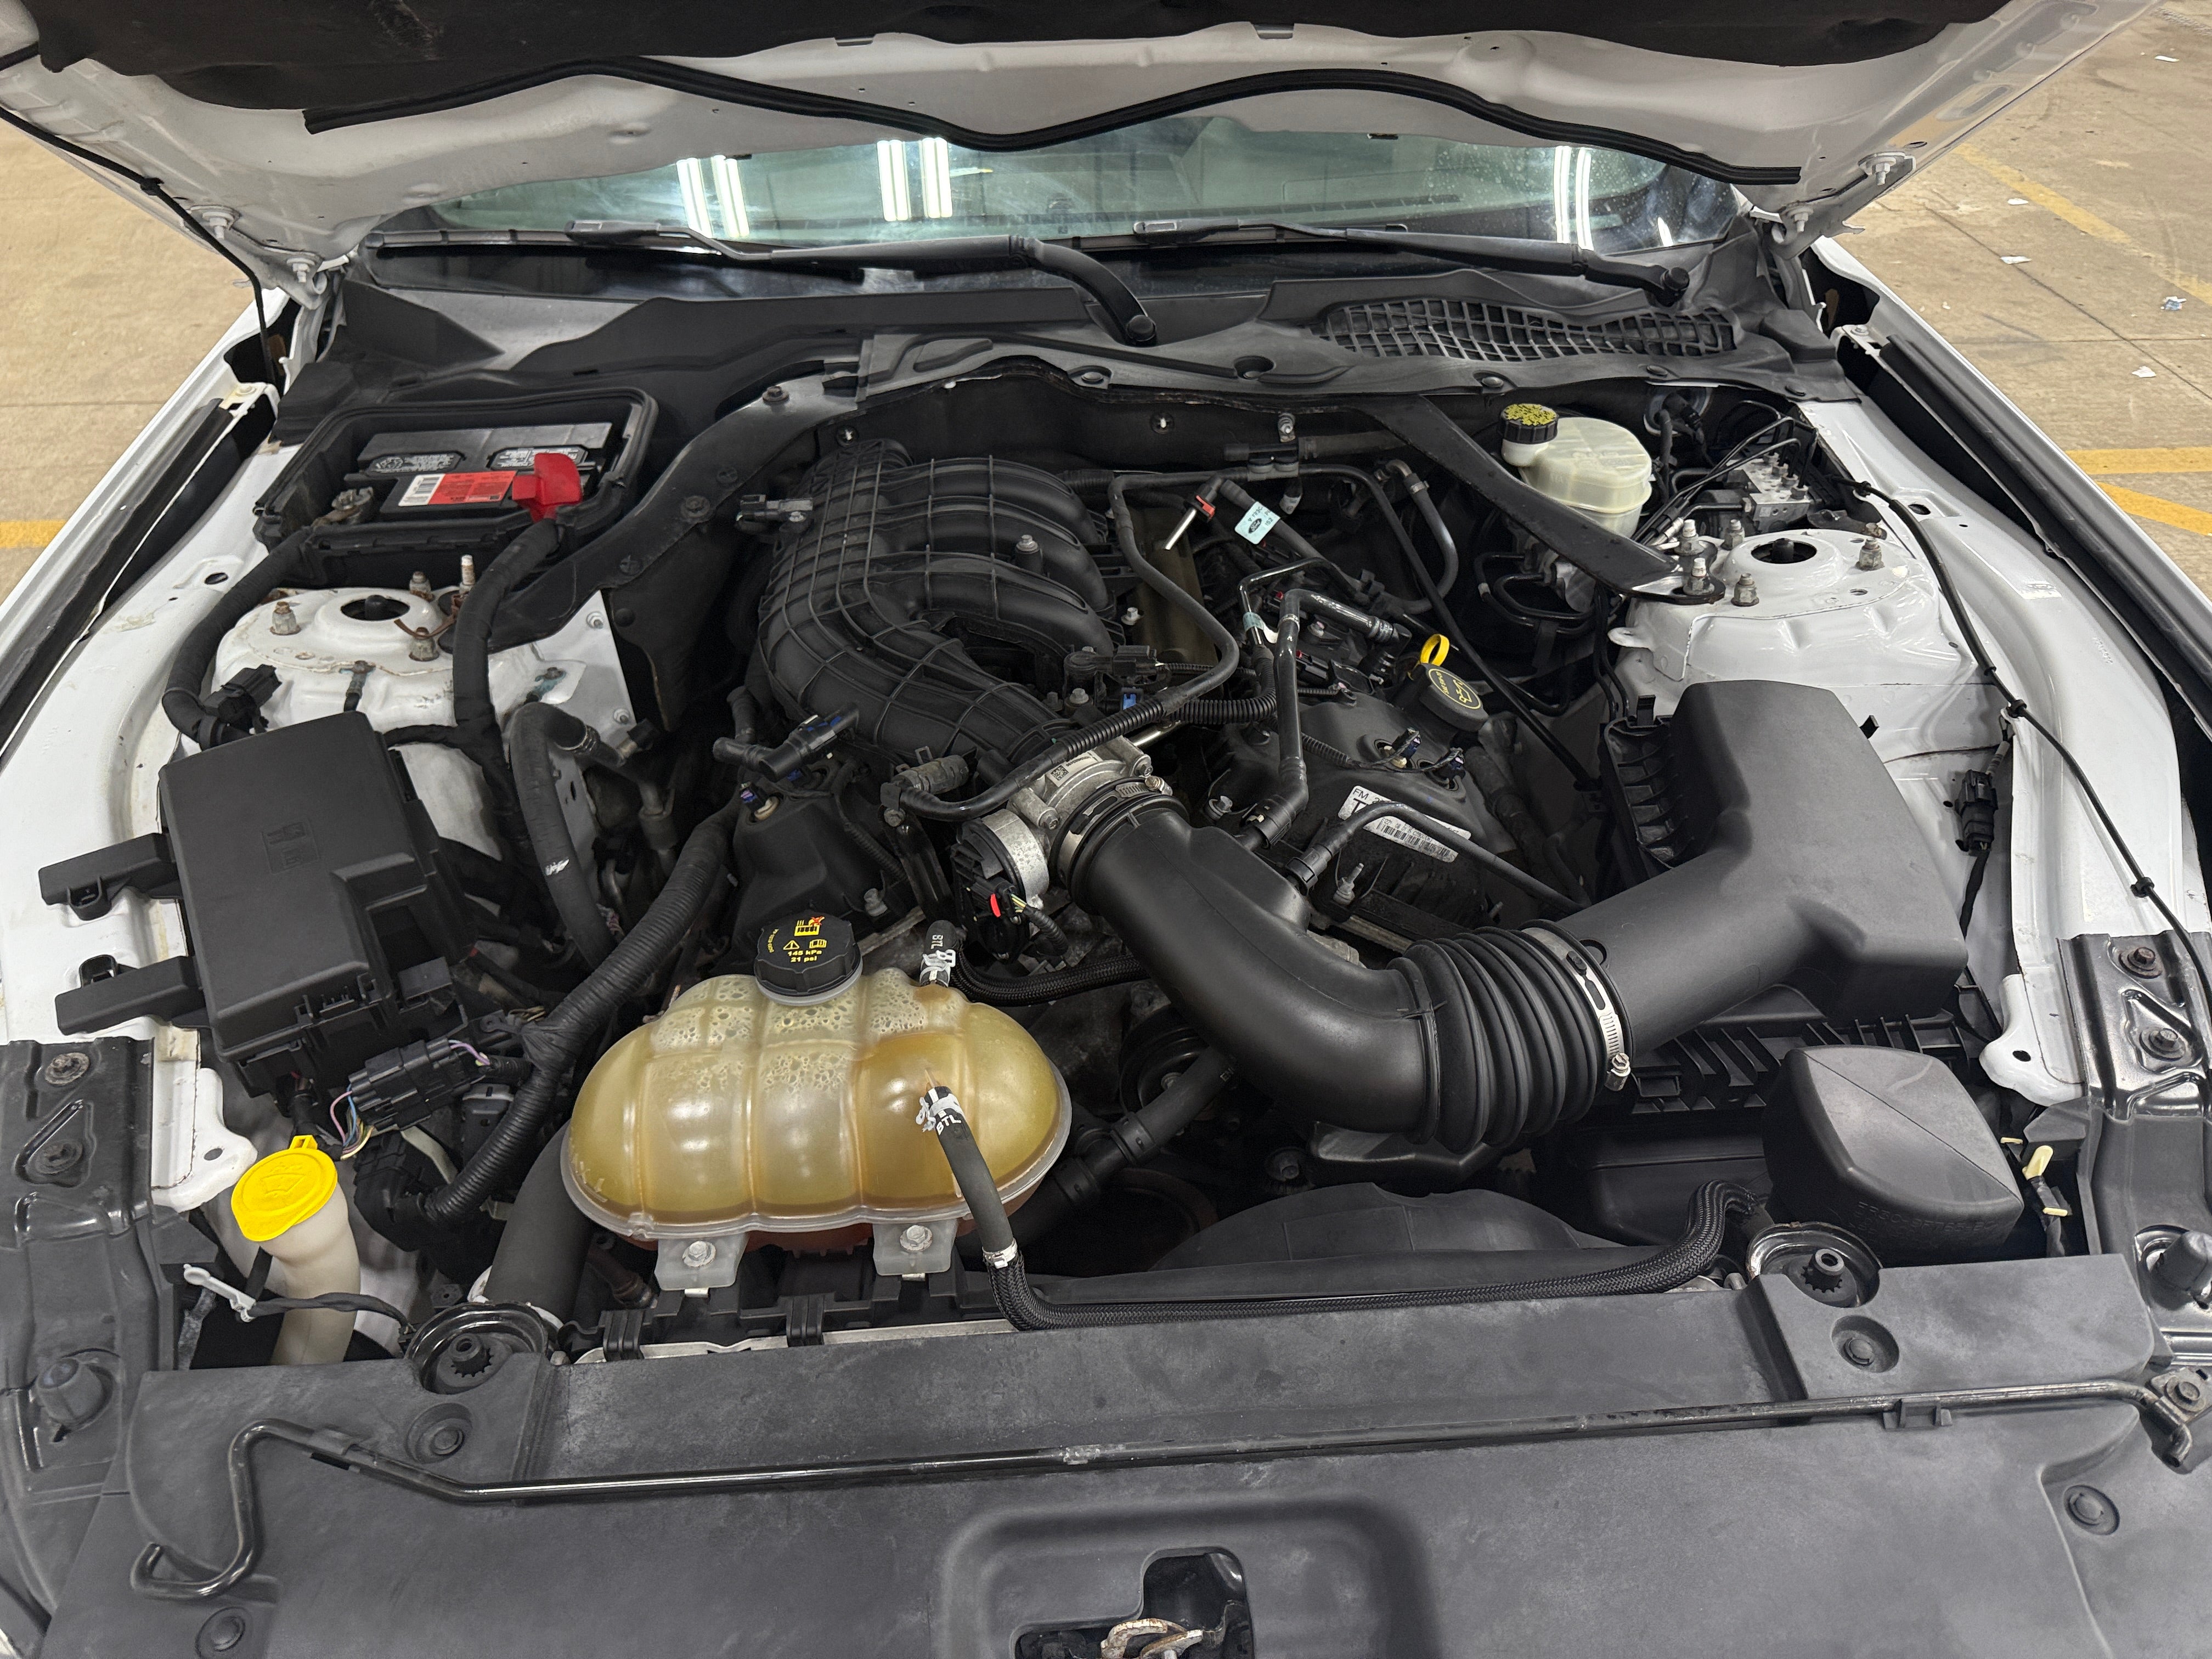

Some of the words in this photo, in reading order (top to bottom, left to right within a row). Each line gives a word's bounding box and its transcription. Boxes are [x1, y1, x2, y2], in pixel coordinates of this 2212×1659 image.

[1352, 788, 1369, 800] FM
[930, 934, 944, 950] BTL
[936, 1114, 962, 1135] BTL
